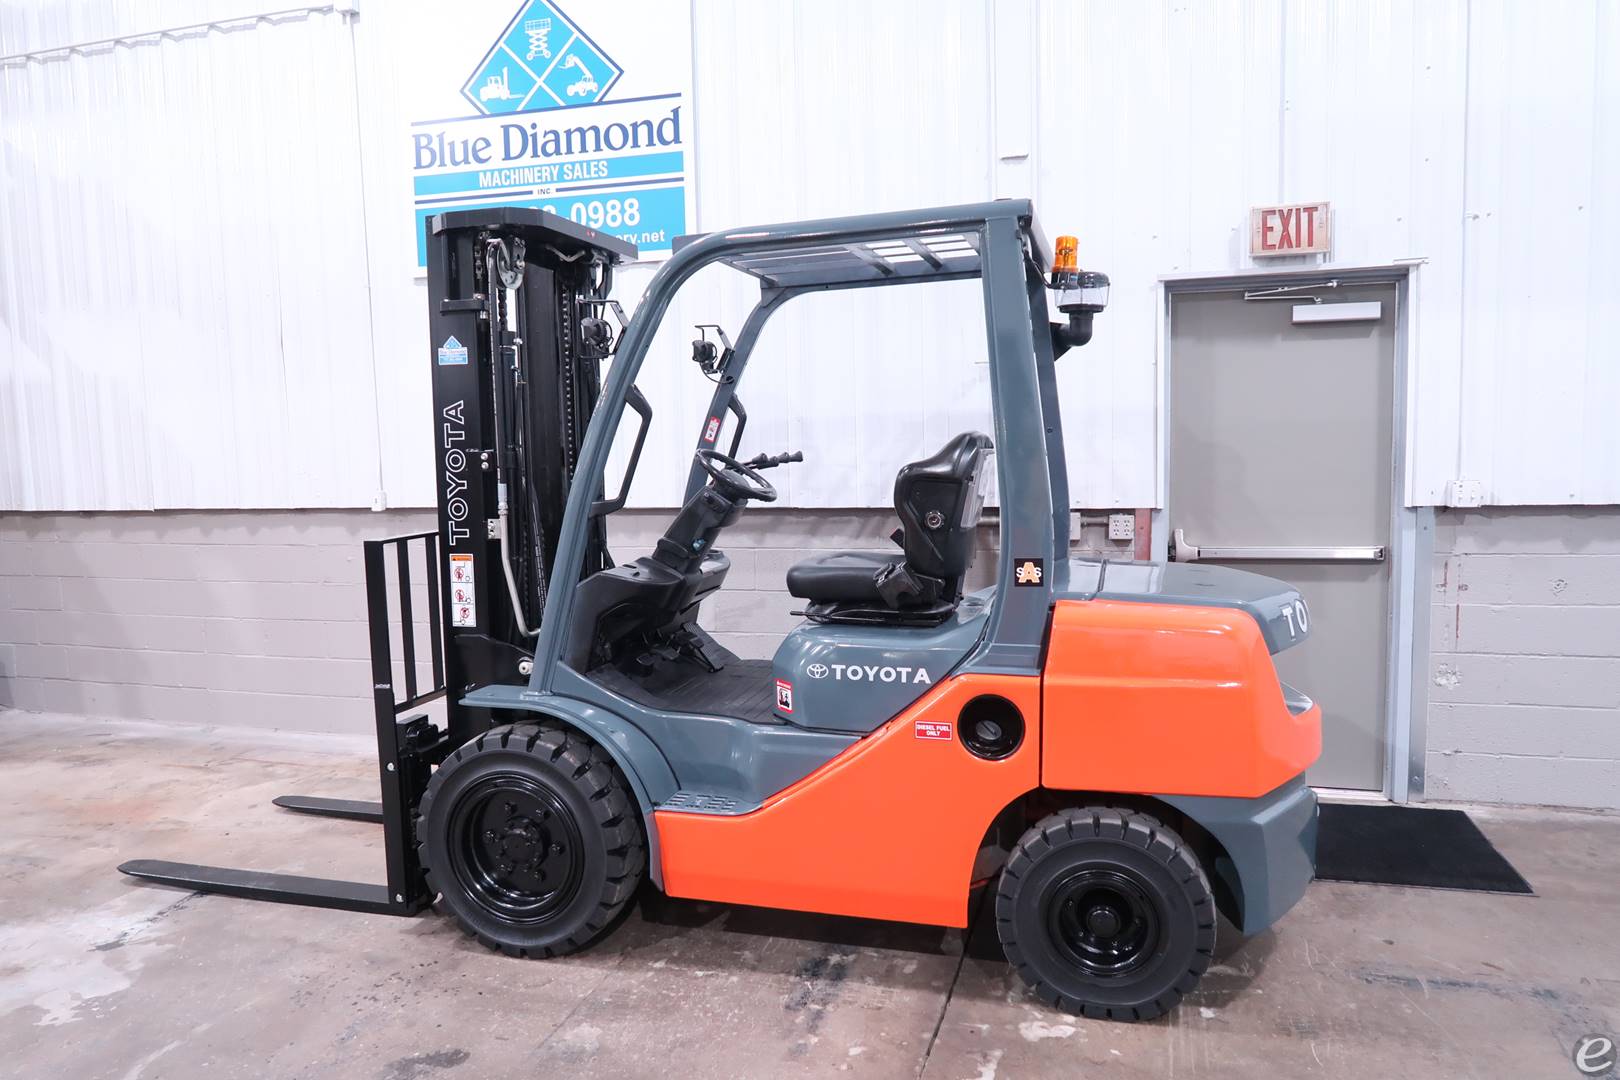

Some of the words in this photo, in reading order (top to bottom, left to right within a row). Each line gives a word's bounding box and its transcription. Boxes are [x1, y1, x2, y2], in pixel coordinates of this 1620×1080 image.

[412, 131, 492, 170] Blue
[501, 105, 683, 162] Diamond
[478, 164, 559, 188] MACHINERY
[563, 160, 609, 182] SALES
[1261, 206, 1319, 250] EXIT
[443, 400, 470, 546] TOYOTA
[831, 664, 931, 684] TOYOTA
